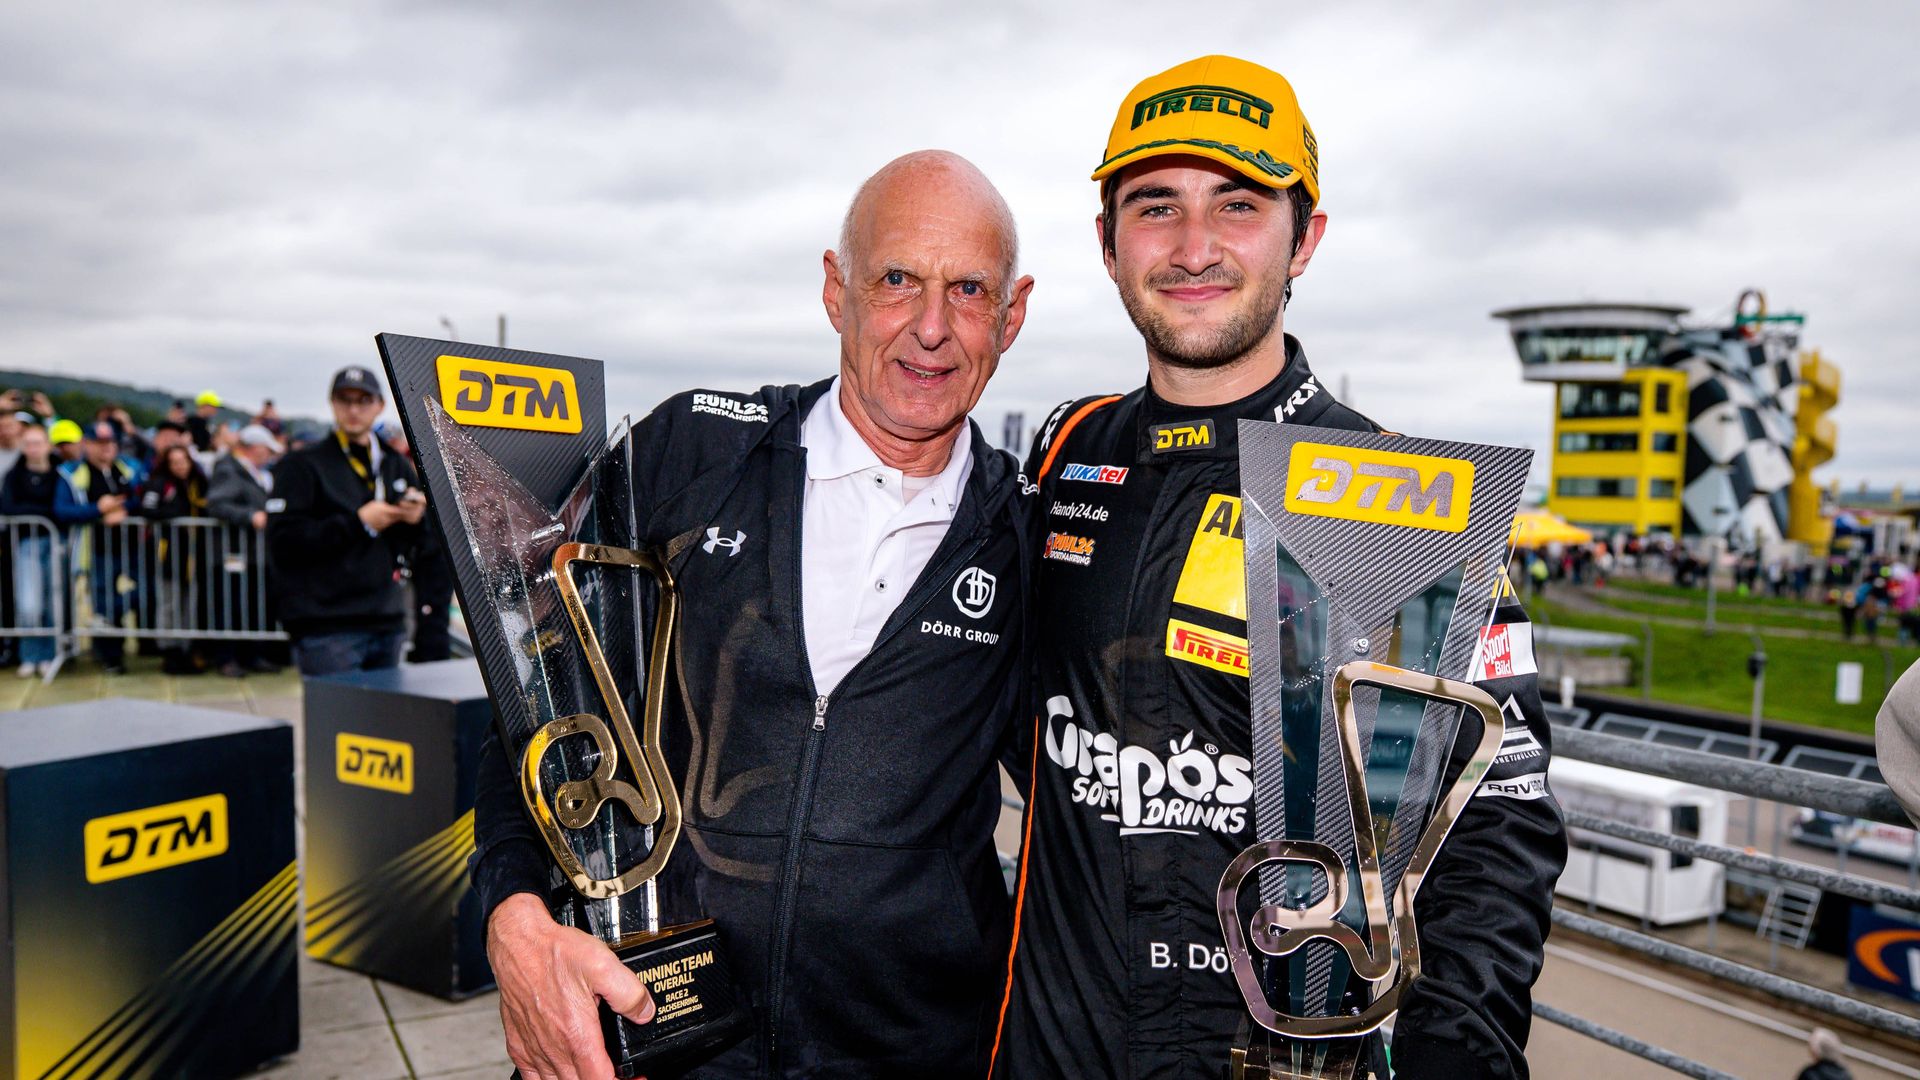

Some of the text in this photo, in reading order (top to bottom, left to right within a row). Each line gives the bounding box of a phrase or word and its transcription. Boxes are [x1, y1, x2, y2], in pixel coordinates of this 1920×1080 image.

[1130, 85, 1274, 131] PIRELLI
[455, 369, 570, 420] DTM
[1273, 375, 1320, 423] HRX
[691, 404, 769, 423] SPORTNAHRUNG
[1156, 425, 1211, 449] DTM
[1295, 456, 1455, 518] DTM
[1050, 500, 1109, 522] Handy24.de
[920, 620, 962, 639] DÖRR
[1172, 628, 1248, 670] PIREL
[1494, 659, 1511, 676] Bild
[343, 745, 405, 782] DTM
[1141, 798, 1247, 834] DRINKS
[99, 810, 214, 867] DTM
[681, 950, 714, 972] TEAM
[1150, 942, 1232, 973] B. Dö
[654, 972, 695, 993] OVERALL
[657, 995, 699, 1015] SACHSENRING
[665, 990, 684, 1003] RACE
